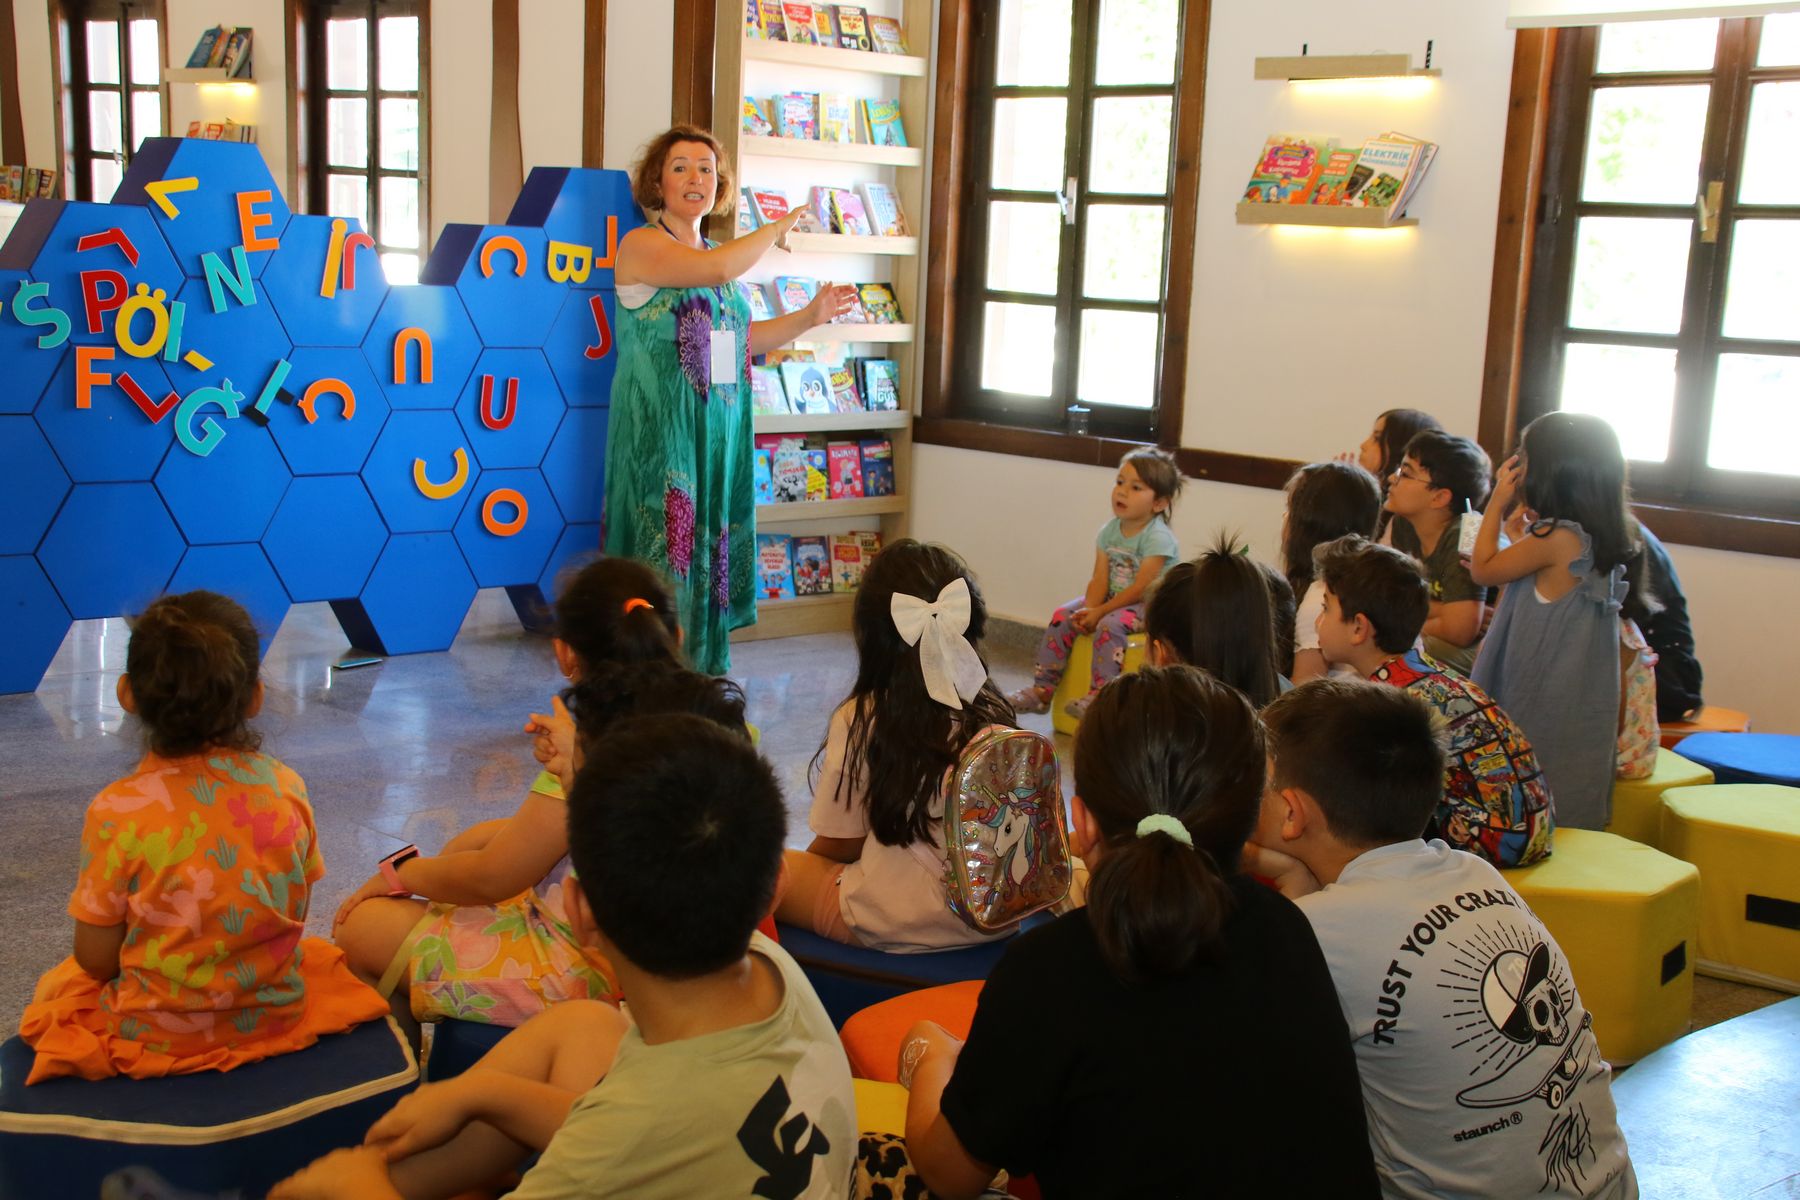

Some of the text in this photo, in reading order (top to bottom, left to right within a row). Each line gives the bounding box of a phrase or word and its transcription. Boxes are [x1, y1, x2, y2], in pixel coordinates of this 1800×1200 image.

[1362, 148, 1410, 161] ELEKTRİK
[236, 190, 280, 252] E
[201, 245, 257, 313] N
[547, 240, 592, 283] B
[80, 269, 129, 334] P
[115, 282, 170, 358] Ö
[584, 295, 612, 360] J
[76, 346, 115, 409] F
[116, 372, 181, 424] L
[480, 374, 520, 431] U
[482, 488, 529, 537] O
[1373, 960, 1413, 1045] TRUST
[1400, 905, 1461, 957] YOUR
